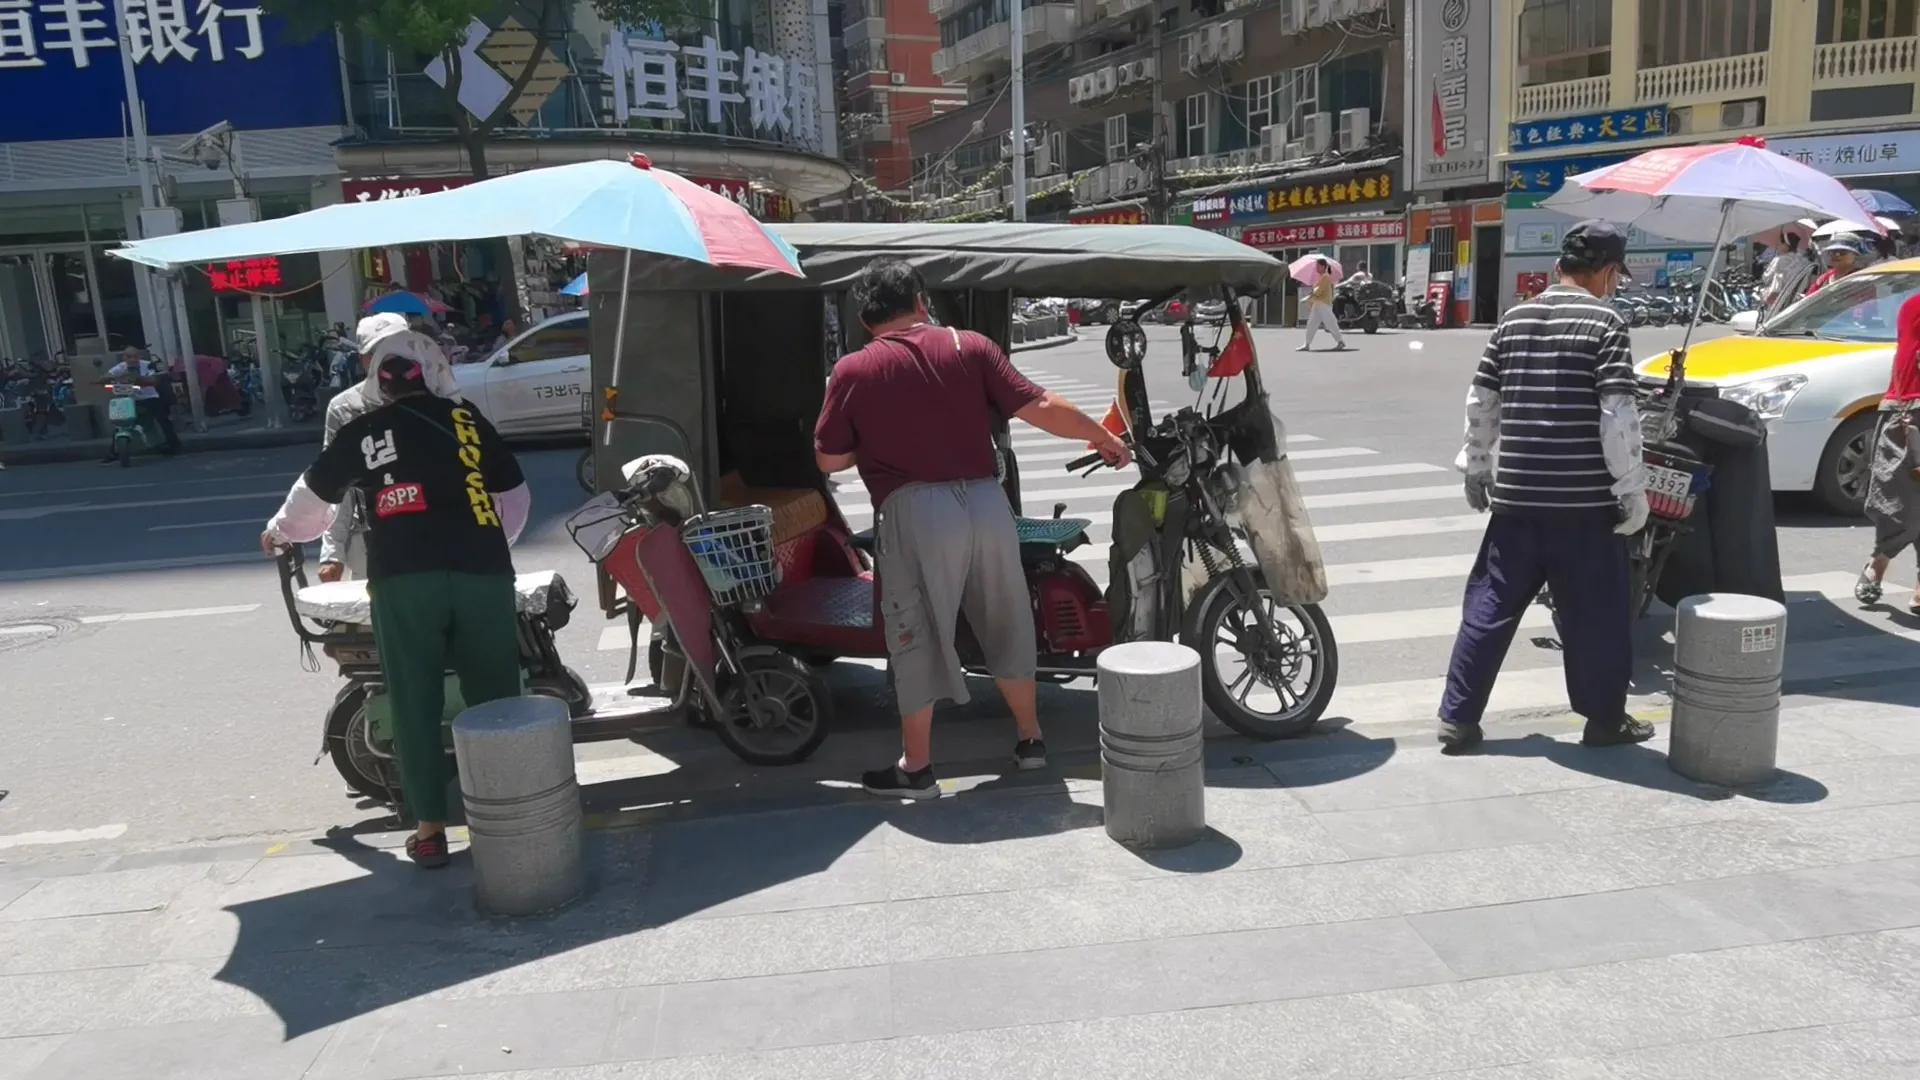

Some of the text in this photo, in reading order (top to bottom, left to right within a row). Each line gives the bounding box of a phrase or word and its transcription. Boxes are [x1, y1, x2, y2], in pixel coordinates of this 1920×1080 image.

[602, 28, 815, 140] 恒丰银行
[533, 384, 581, 399] T3出行
[1648, 475, 1685, 495] 9392
